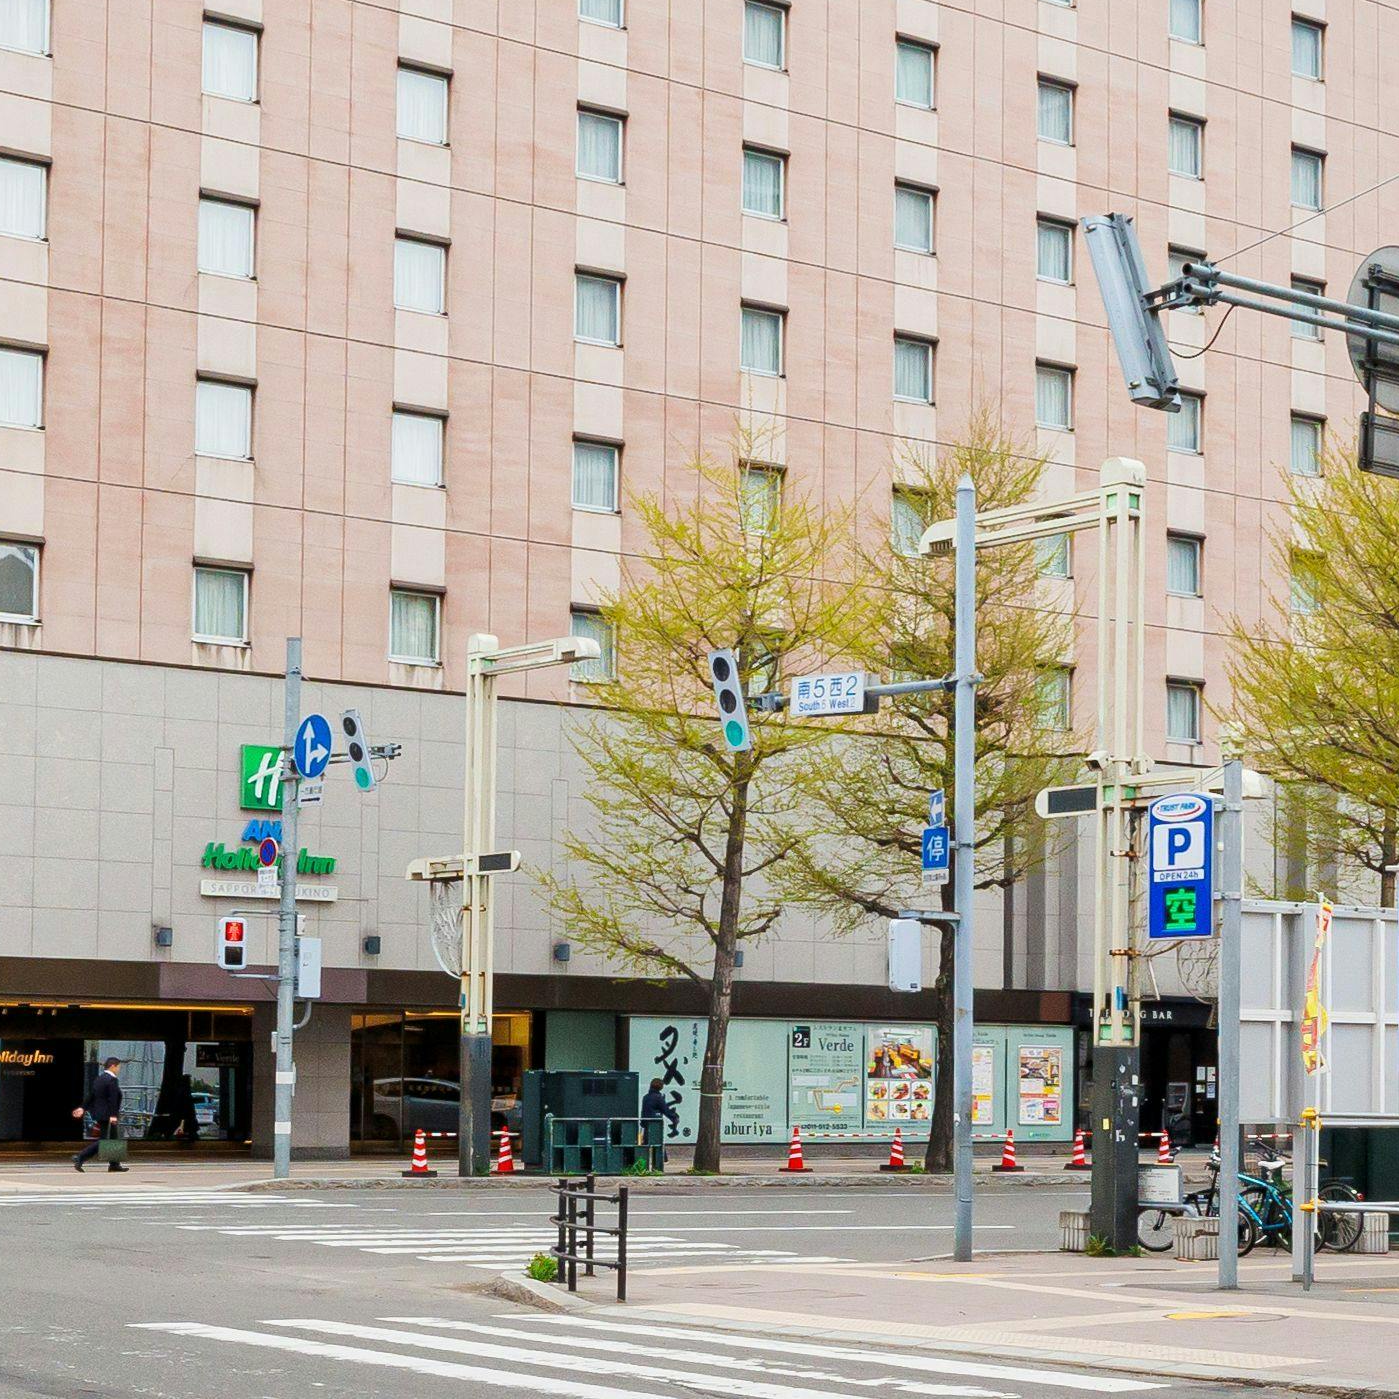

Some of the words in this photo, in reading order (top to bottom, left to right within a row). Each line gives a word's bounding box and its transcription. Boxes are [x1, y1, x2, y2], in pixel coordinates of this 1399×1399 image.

[797, 675, 857, 699] 南5西2
[798, 701, 820, 712] South
[829, 699, 849, 709] West
[1157, 803, 1181, 813] TRUST
[1182, 801, 1197, 811] PARK
[242, 819, 283, 843] AN
[926, 836, 945, 862] 停
[1168, 827, 1191, 866] P
[297, 848, 337, 874] Inn
[1160, 872, 1181, 881] OPEN
[1183, 870, 1199, 880] 24h
[1165, 888, 1197, 930] 空
[1152, 1010, 1173, 1020] BAR
[794, 1033, 809, 1047] 2F
[818, 1037, 854, 1052] Verde
[34, 1050, 54, 1063] Inn
[724, 1122, 773, 1136] aburiya
